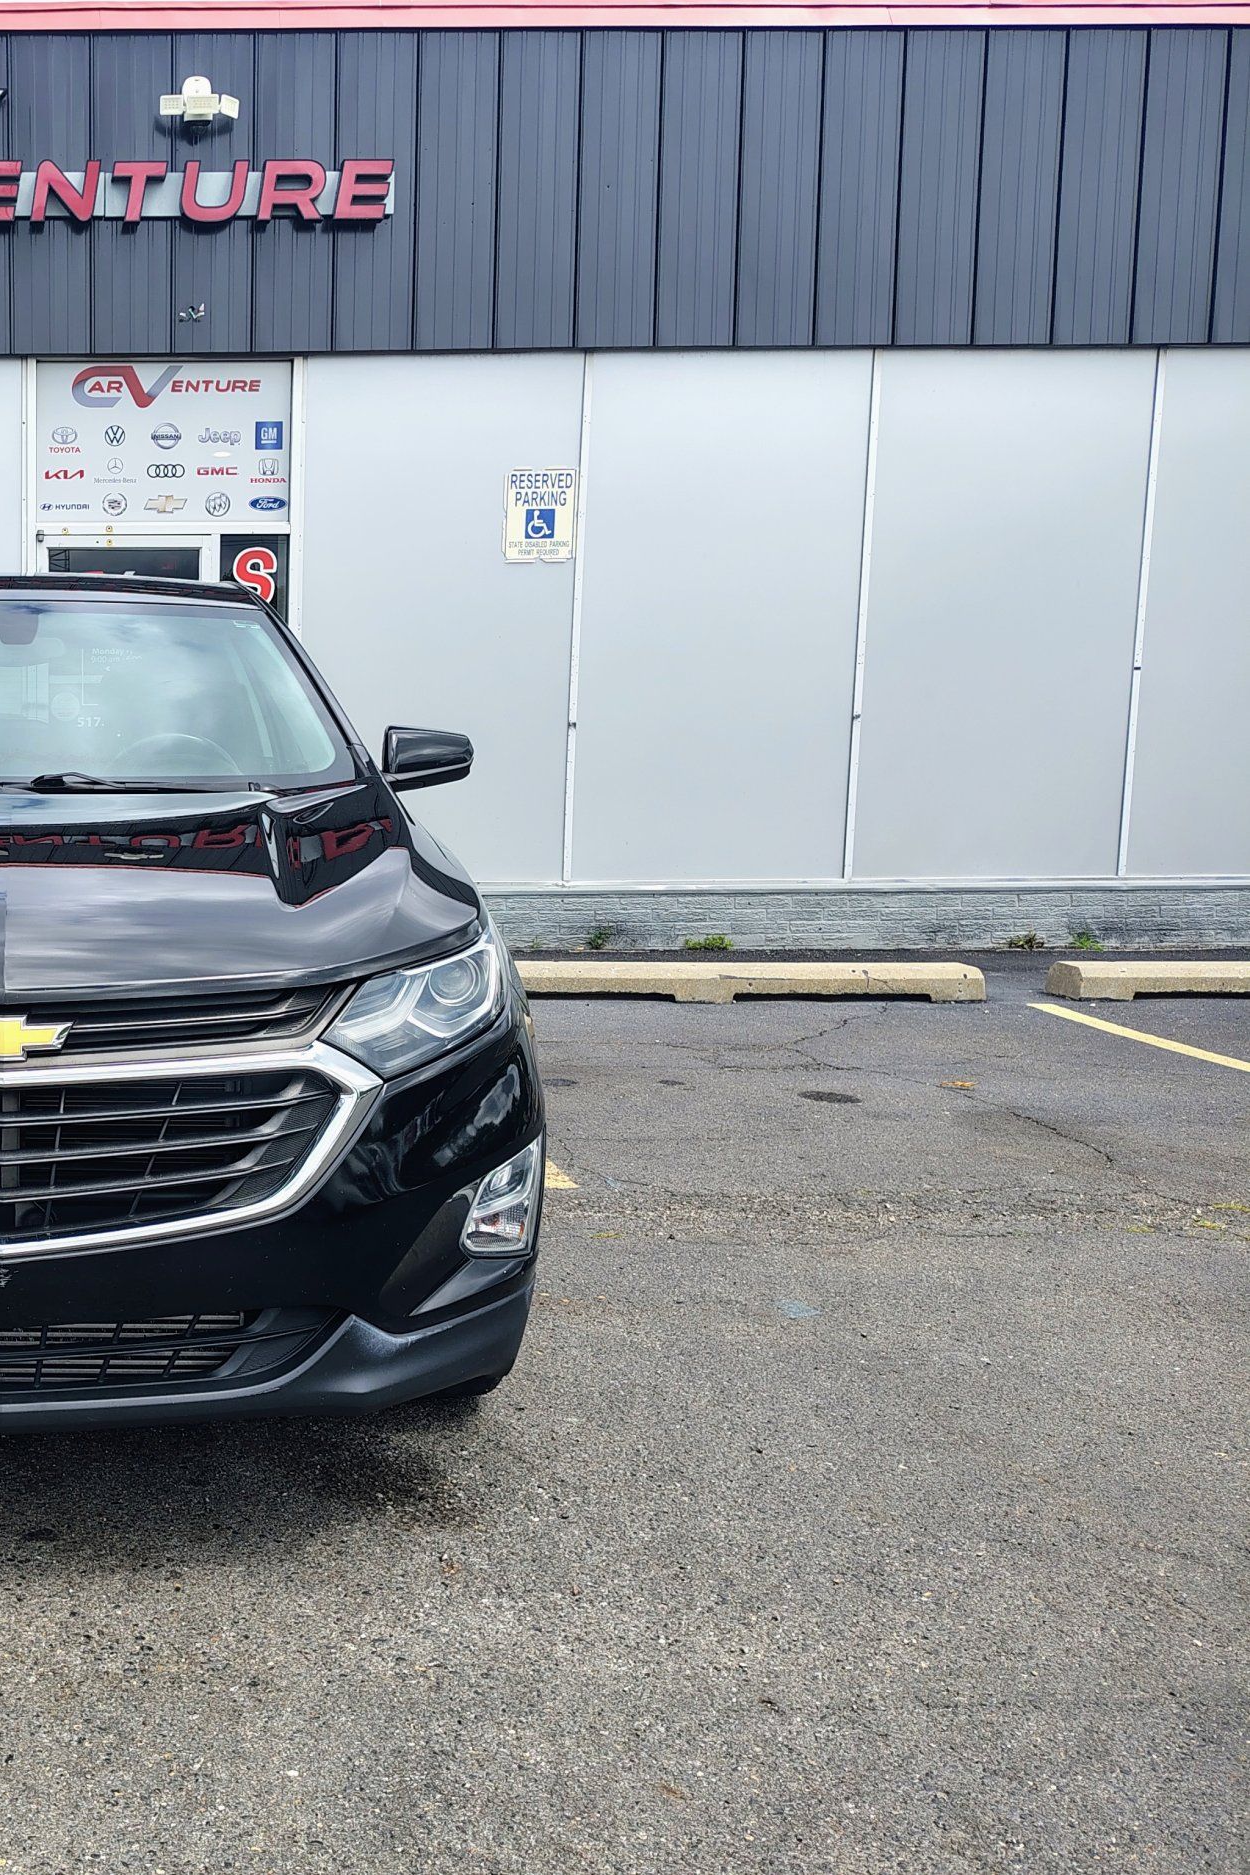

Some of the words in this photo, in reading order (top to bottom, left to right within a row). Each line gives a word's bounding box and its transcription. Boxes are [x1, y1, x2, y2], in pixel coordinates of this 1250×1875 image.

[198, 428, 241, 445] Jeep
[261, 427, 277, 440] GM
[49, 446, 81, 454] TOYOTA
[44, 469, 85, 480] KIA
[197, 466, 238, 476] GMC
[510, 473, 573, 489] RESERVED
[256, 498, 280, 509] Ford
[514, 490, 567, 507] PARKING
[508, 541, 524, 549] STATE
[525, 540, 548, 548] DISABLED
[549, 540, 570, 548] PARKING
